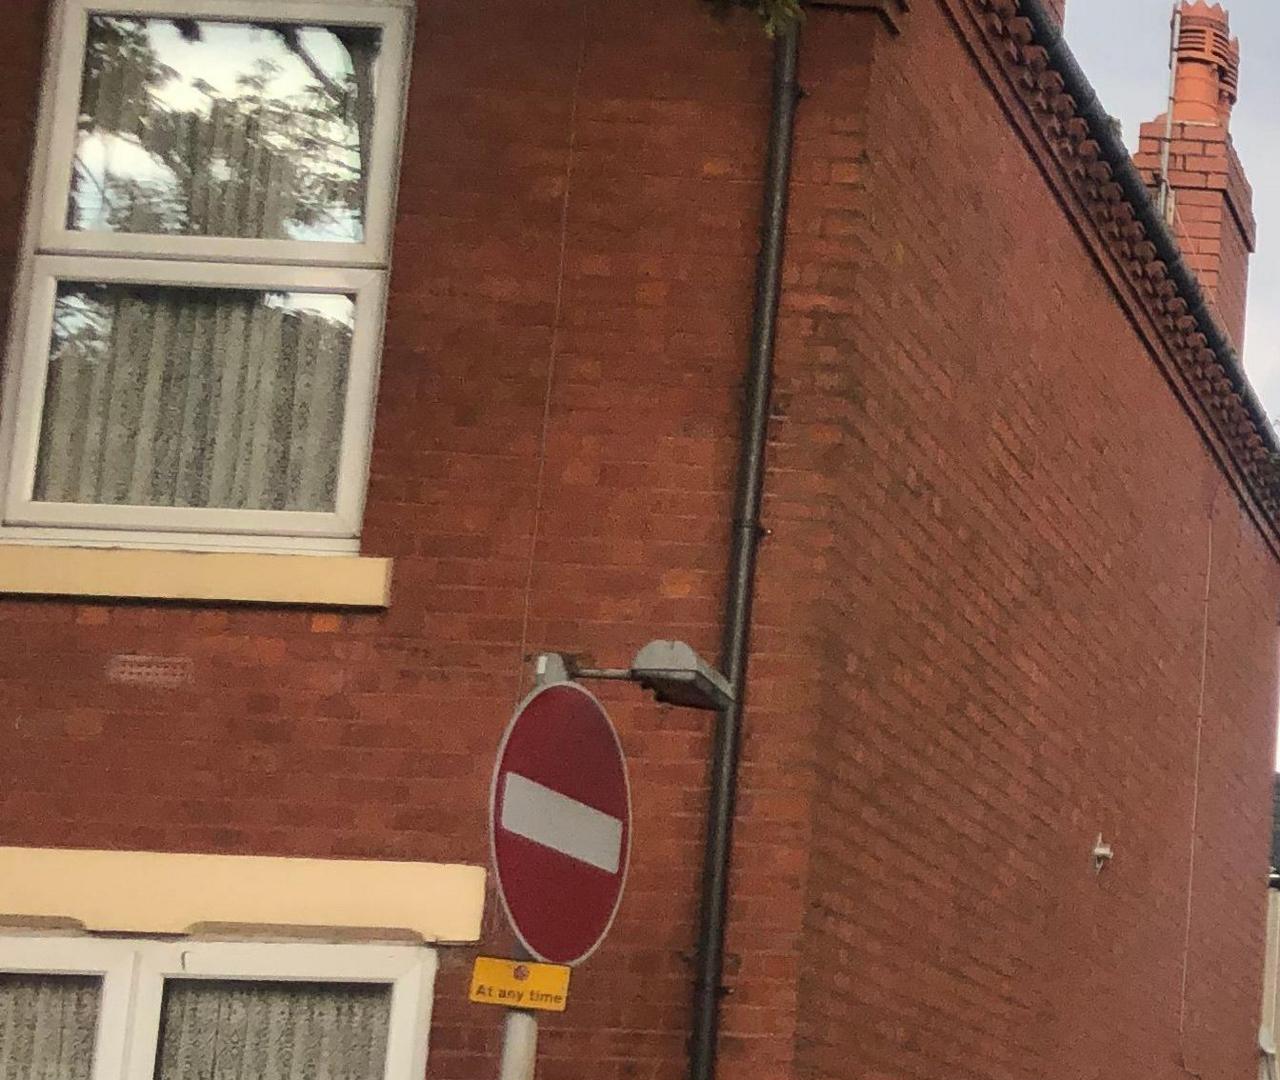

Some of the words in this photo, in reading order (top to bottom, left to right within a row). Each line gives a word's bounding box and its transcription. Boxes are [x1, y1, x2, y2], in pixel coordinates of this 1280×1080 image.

[476, 985, 492, 997] At
[499, 989, 523, 1001] any
[530, 990, 562, 1003] time
